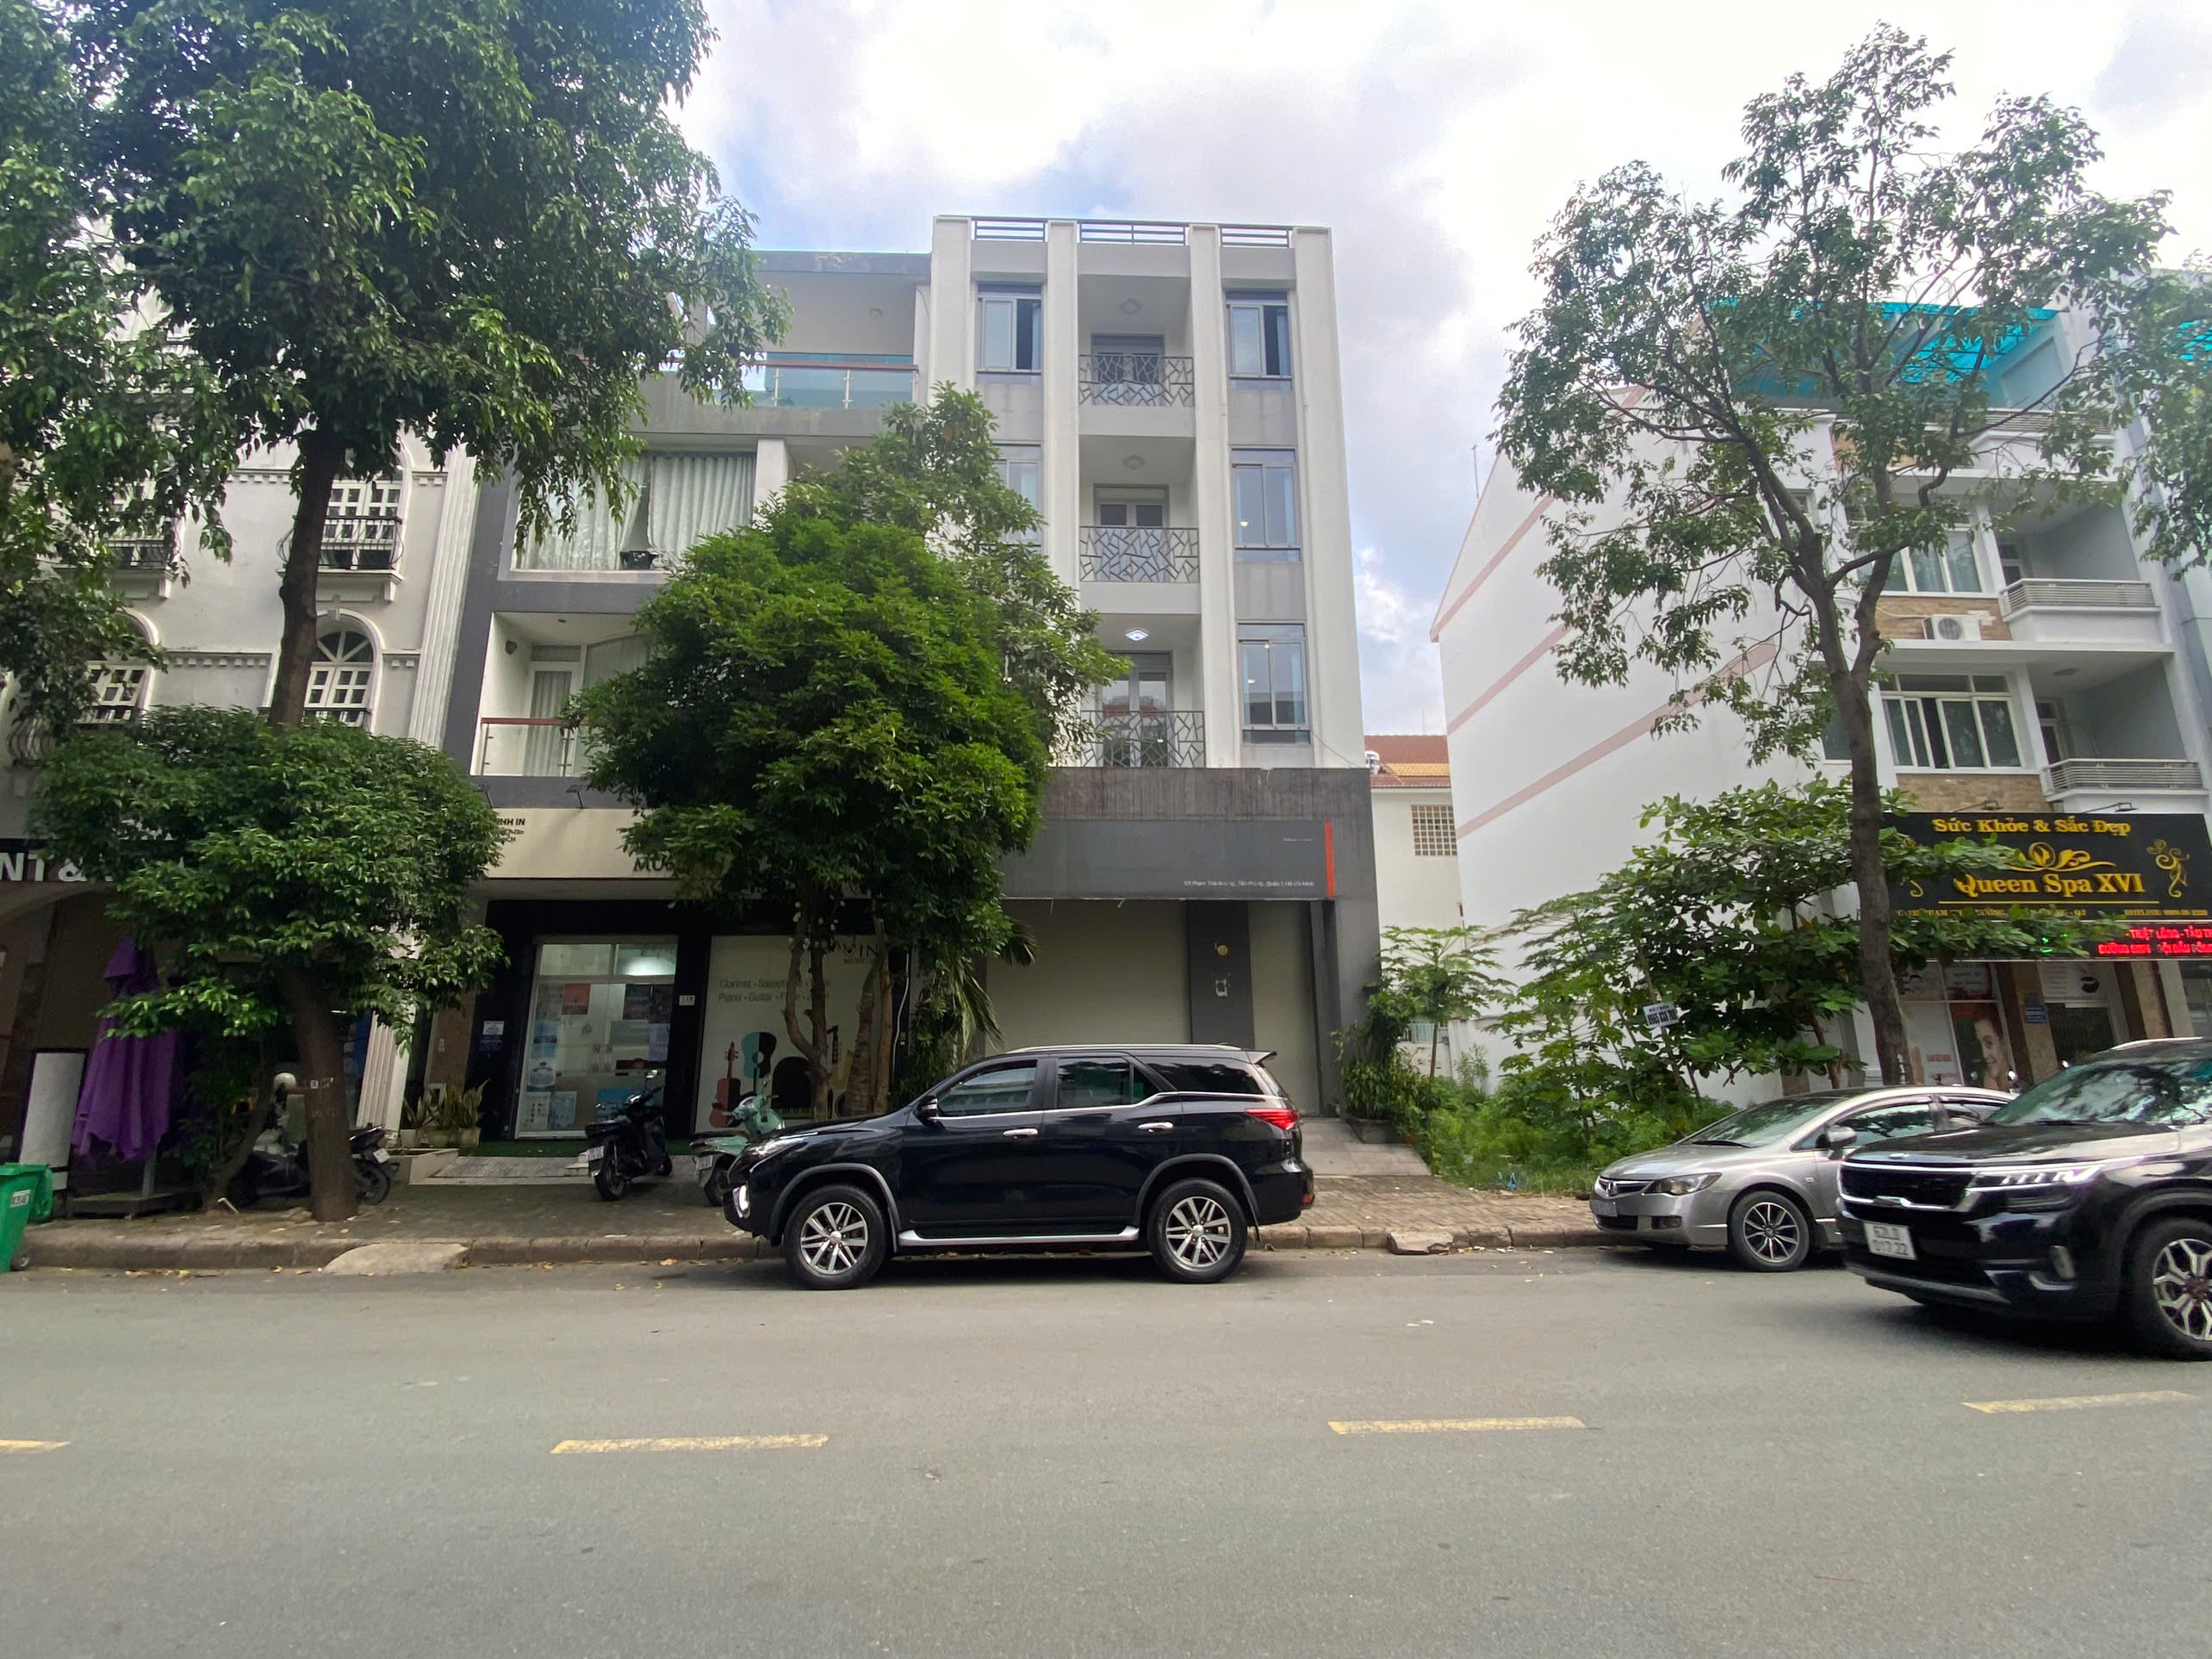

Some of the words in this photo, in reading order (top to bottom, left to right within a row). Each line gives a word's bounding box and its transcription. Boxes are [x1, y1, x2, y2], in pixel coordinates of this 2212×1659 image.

[1932, 817, 1972, 832] Sức
[1976, 817, 2029, 832] Khỏe
[2033, 819, 2051, 832] &
[2054, 815, 2089, 832] Sắc
[2091, 820, 2131, 837] Đẹp
[1954, 873, 2039, 898] Queen
[2042, 873, 2093, 898] Spa
[2094, 873, 2146, 892] XVI
